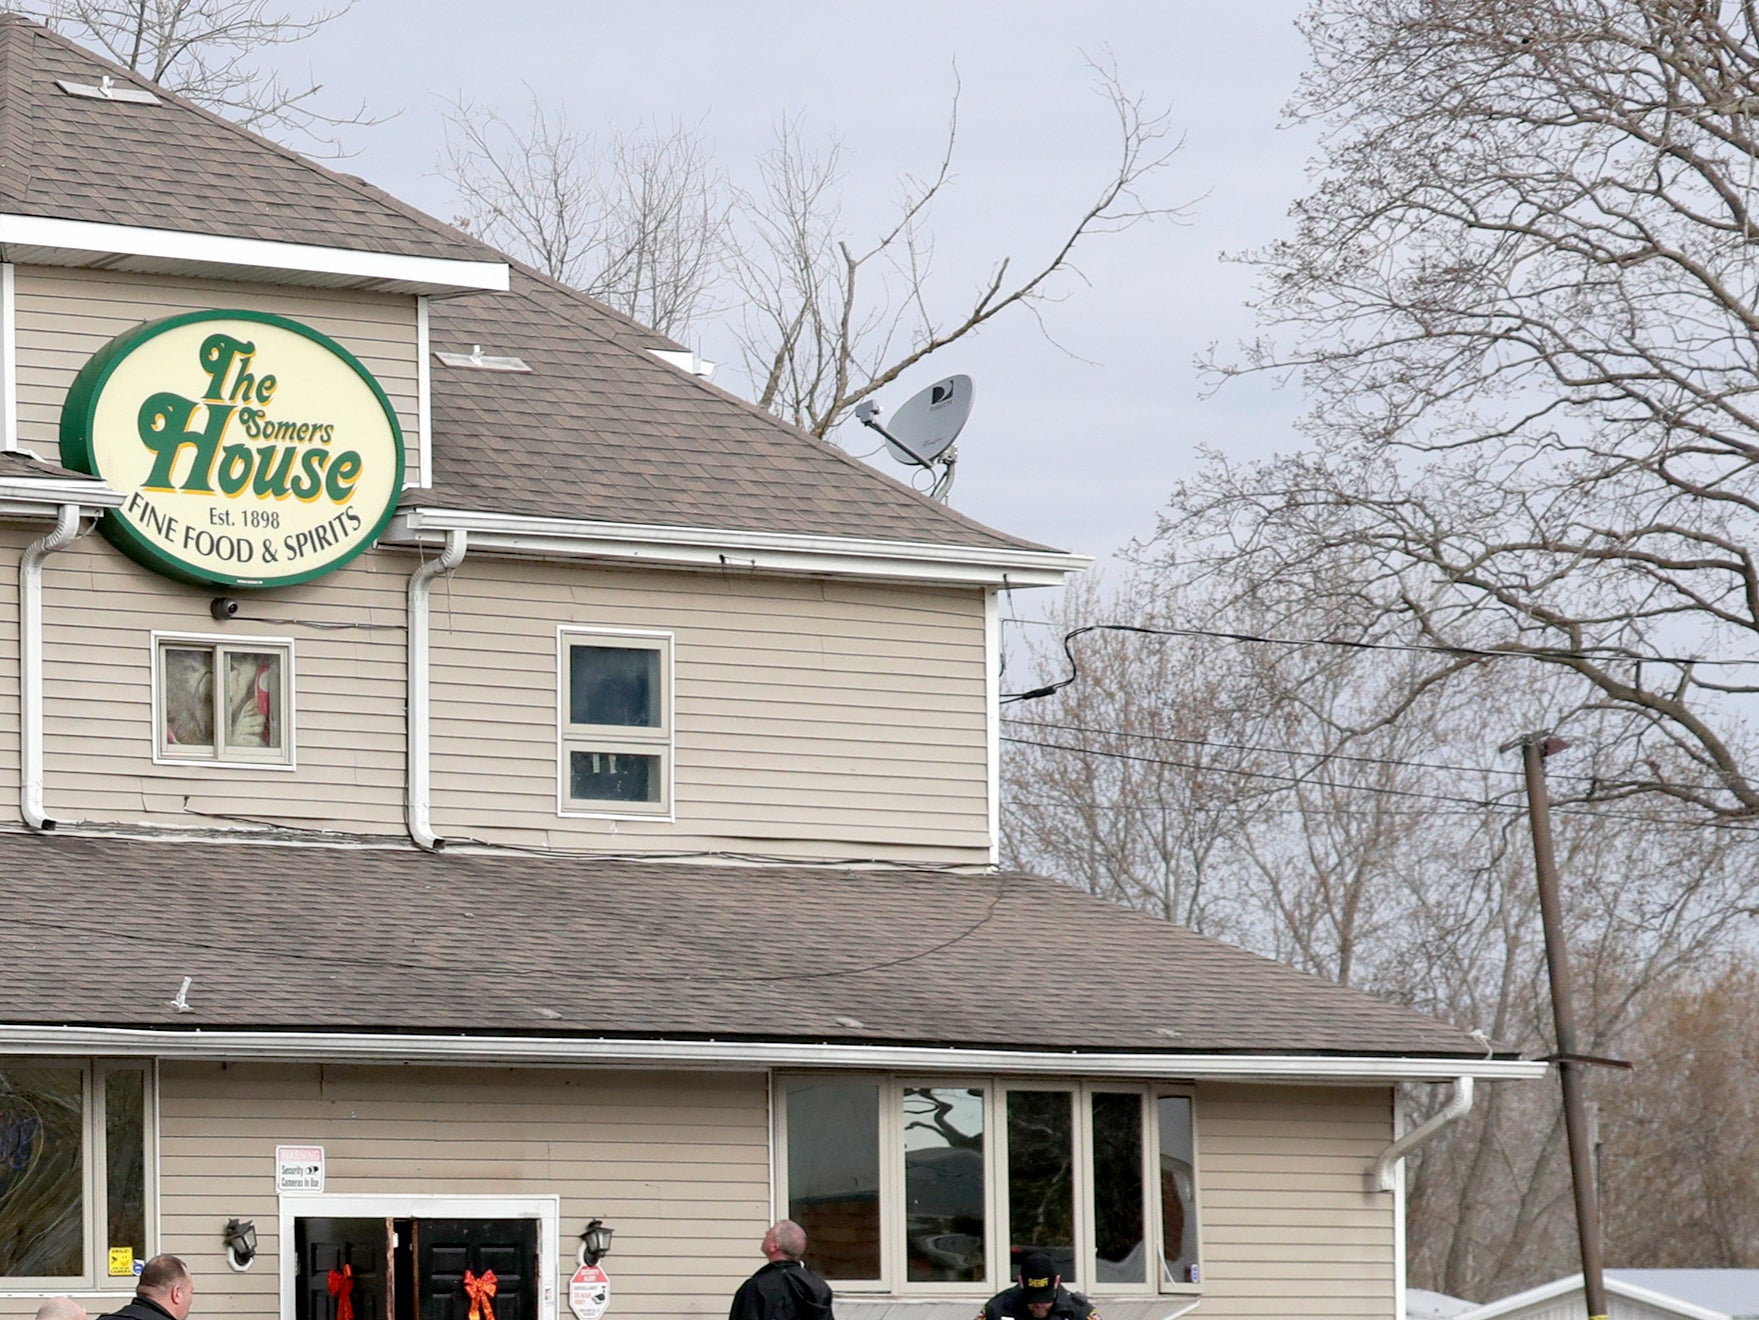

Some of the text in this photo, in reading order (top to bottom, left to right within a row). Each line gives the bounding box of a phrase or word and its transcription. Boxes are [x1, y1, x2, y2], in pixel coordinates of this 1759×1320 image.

[200, 333, 277, 406] The
[138, 392, 362, 505] House
[240, 407, 334, 445] Somers
[128, 491, 362, 563] FINE FOOD & SPIRITS
[209, 507, 280, 530] Est. 1898
